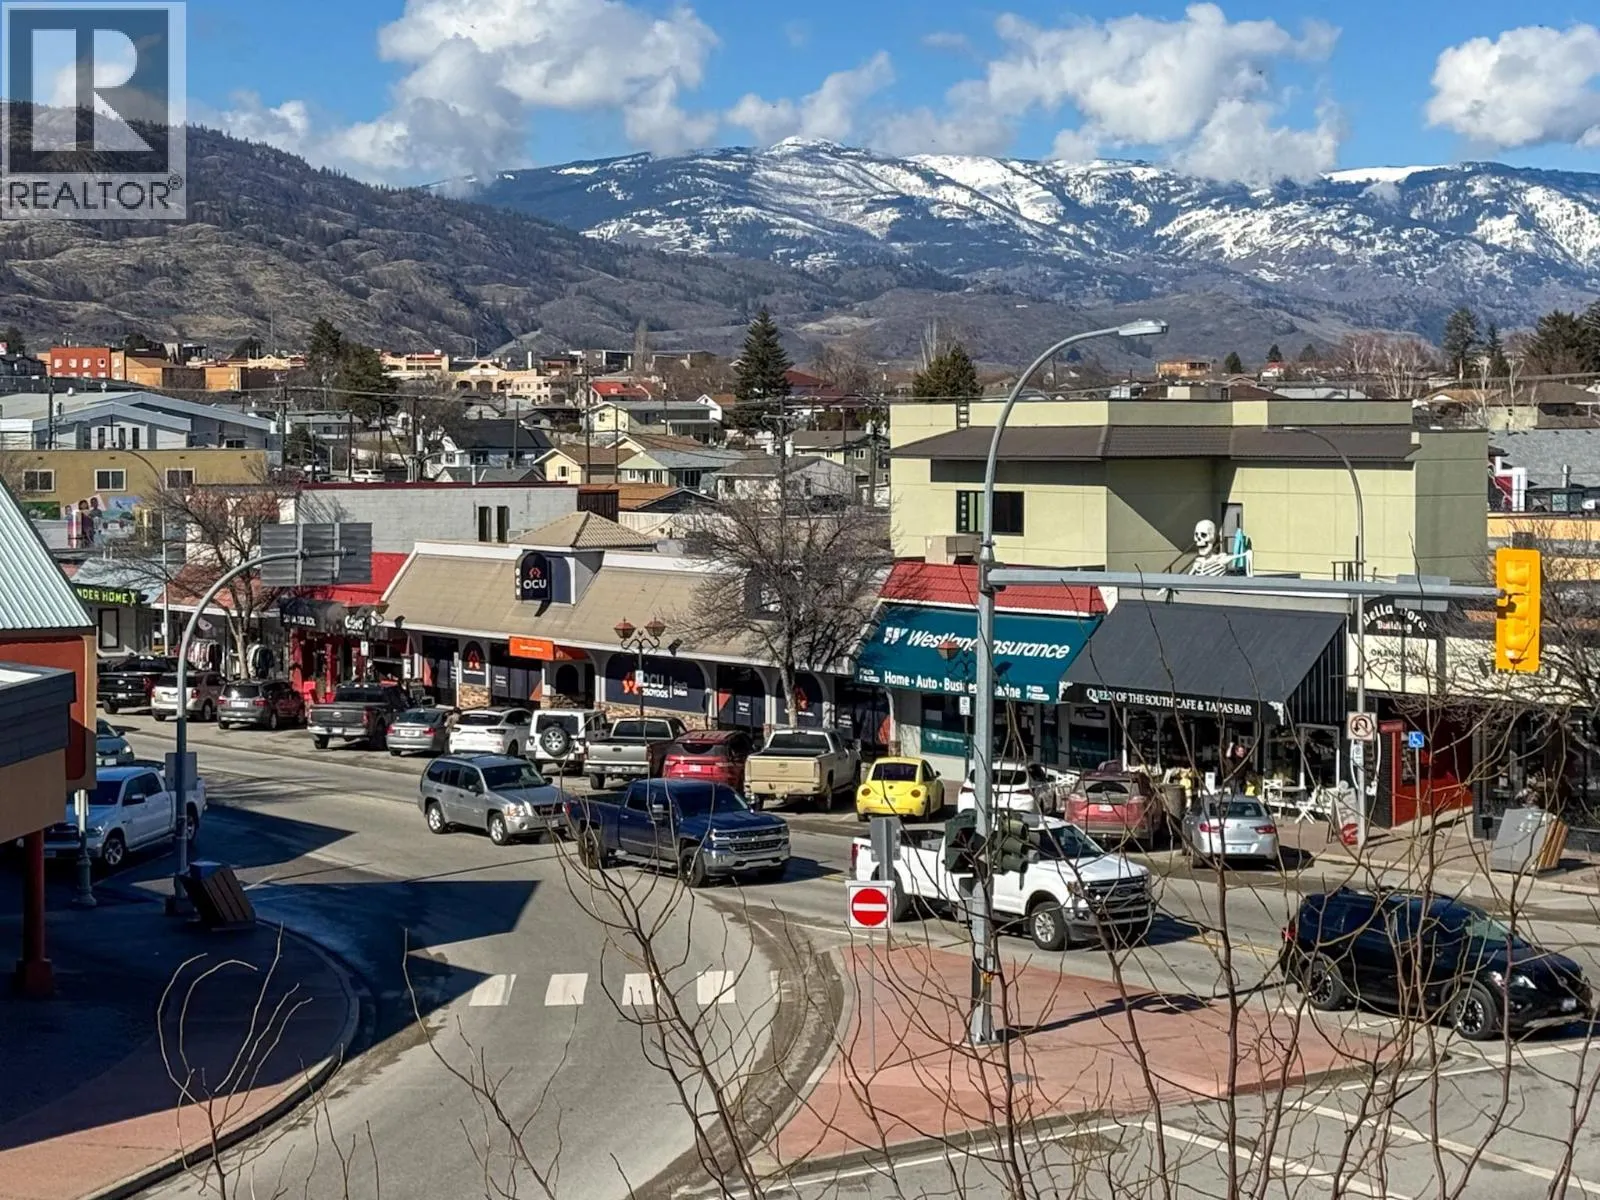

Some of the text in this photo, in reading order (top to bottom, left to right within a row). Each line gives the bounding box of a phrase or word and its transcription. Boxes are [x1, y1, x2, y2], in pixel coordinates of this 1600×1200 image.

[523, 579, 547, 589] OCU
[102, 591, 129, 604] HOME
[991, 639, 1071, 660] nsurance
[884, 670, 911, 687] Home
[916, 675, 938, 690] Auto
[943, 677, 978, 695] Busies
[994, 683, 1021, 699] arine
[1116, 691, 1128, 702] OF
[1128, 692, 1145, 705] THE
[1145, 694, 1174, 708] SOUTH
[1197, 700, 1204, 711] &
[1234, 703, 1253, 716] BAR
